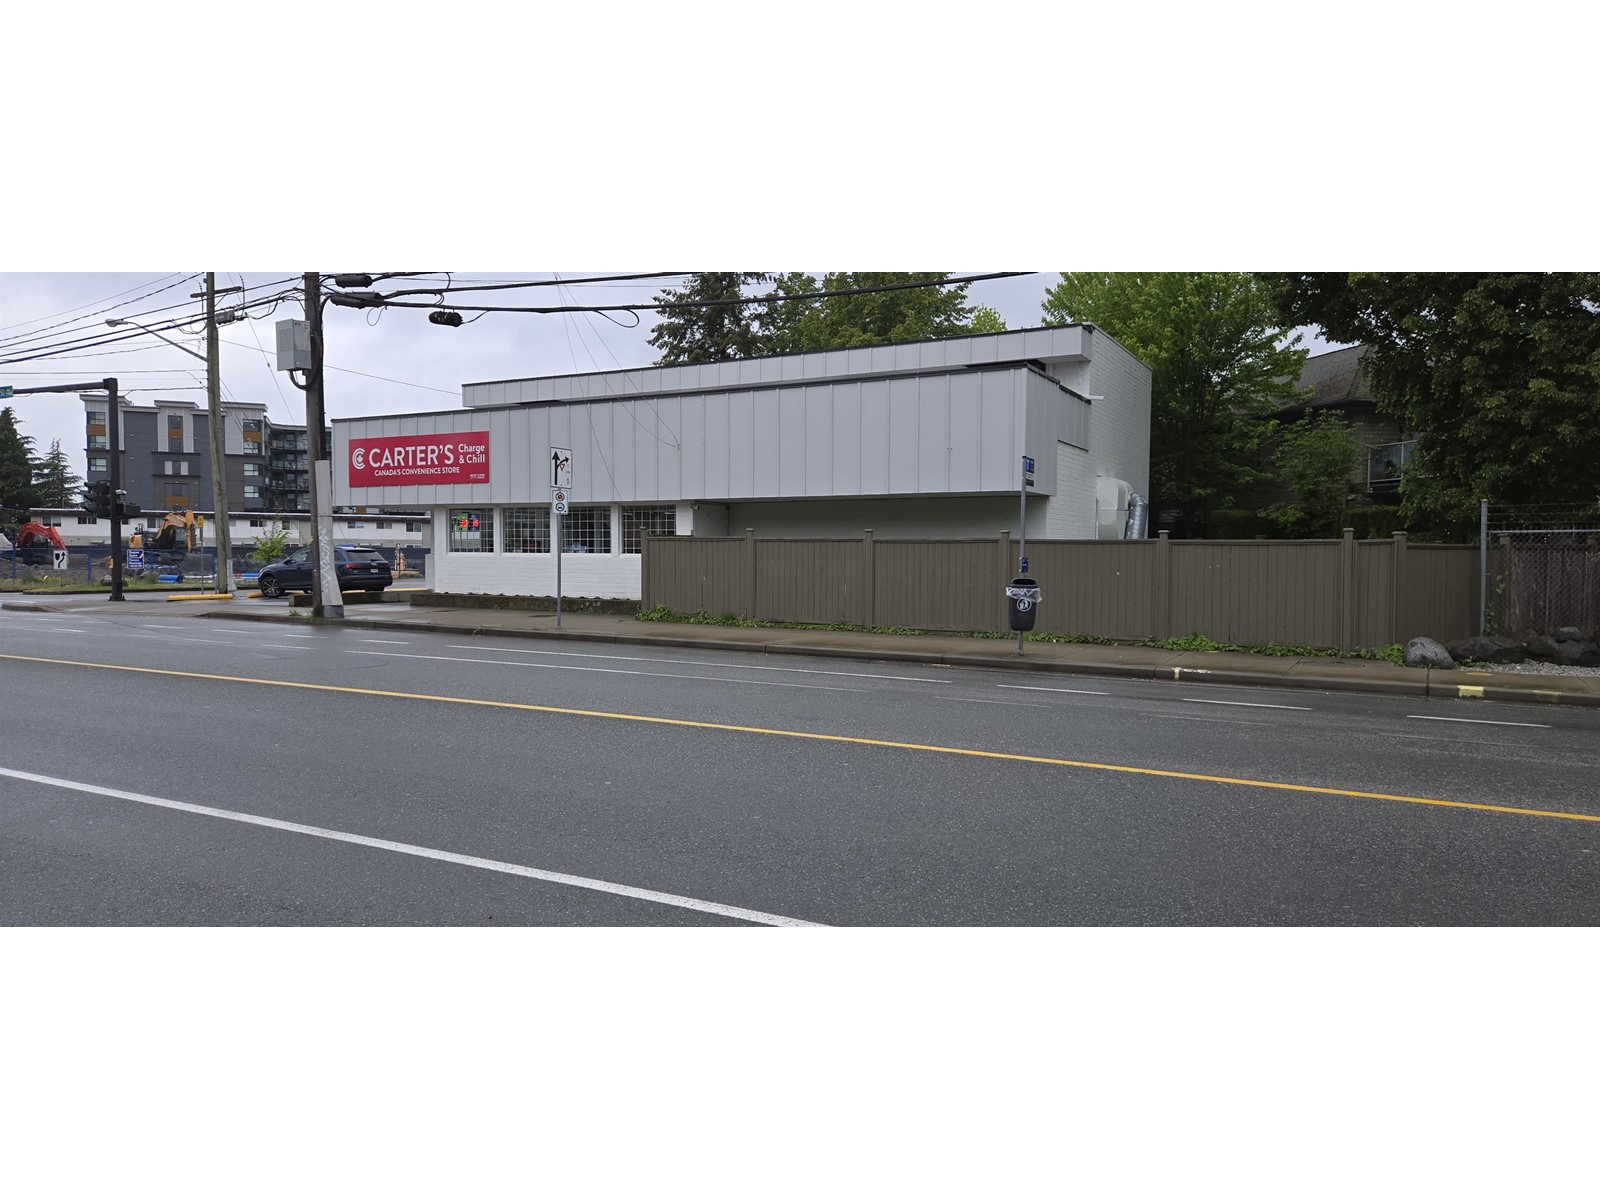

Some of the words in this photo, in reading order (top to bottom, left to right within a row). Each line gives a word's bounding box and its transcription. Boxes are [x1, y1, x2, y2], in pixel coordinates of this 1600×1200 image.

[458, 443, 485, 454] Charge
[368, 444, 454, 468] CARTER'S
[458, 455, 465, 464] &
[466, 454, 485, 463] Chill
[374, 468, 401, 476] CANADA'S
[401, 467, 441, 475] CONVENIENCE
[442, 466, 460, 474] STORE
